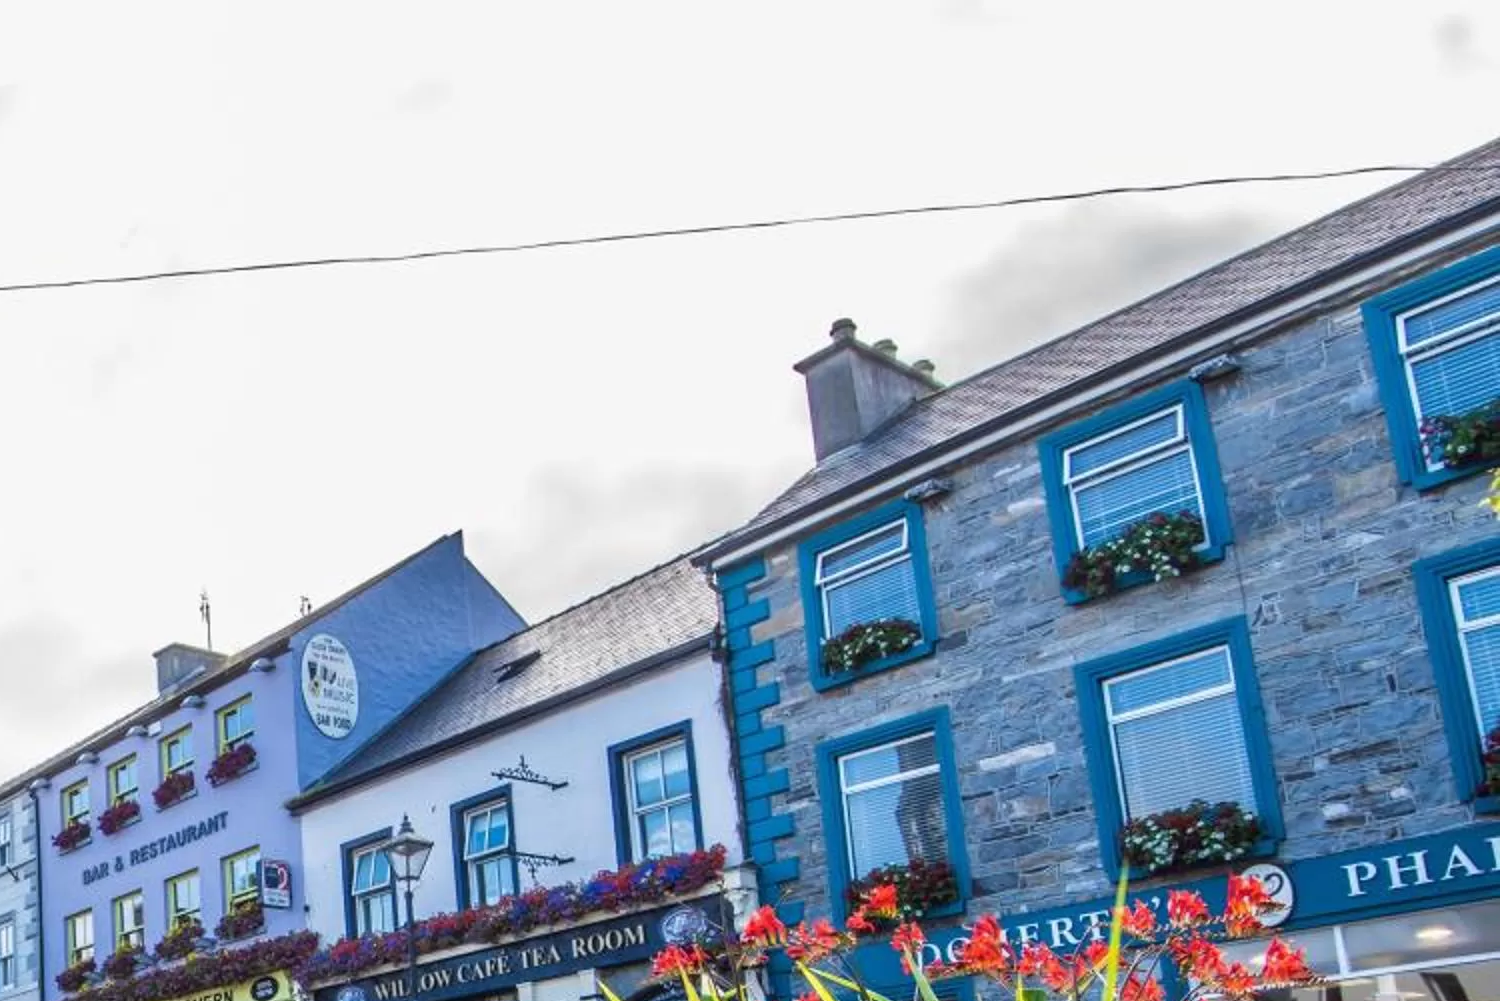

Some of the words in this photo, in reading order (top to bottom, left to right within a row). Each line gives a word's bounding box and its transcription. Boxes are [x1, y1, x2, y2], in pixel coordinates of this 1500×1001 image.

[83, 862, 109, 885] BAR
[114, 856, 124, 873] &
[130, 811, 228, 866] RESTAURANT
[373, 968, 454, 1001] WILOW
[457, 947, 511, 984] CAFÉ
[517, 946, 561, 970] TEA
[571, 924, 646, 960] ROOM
